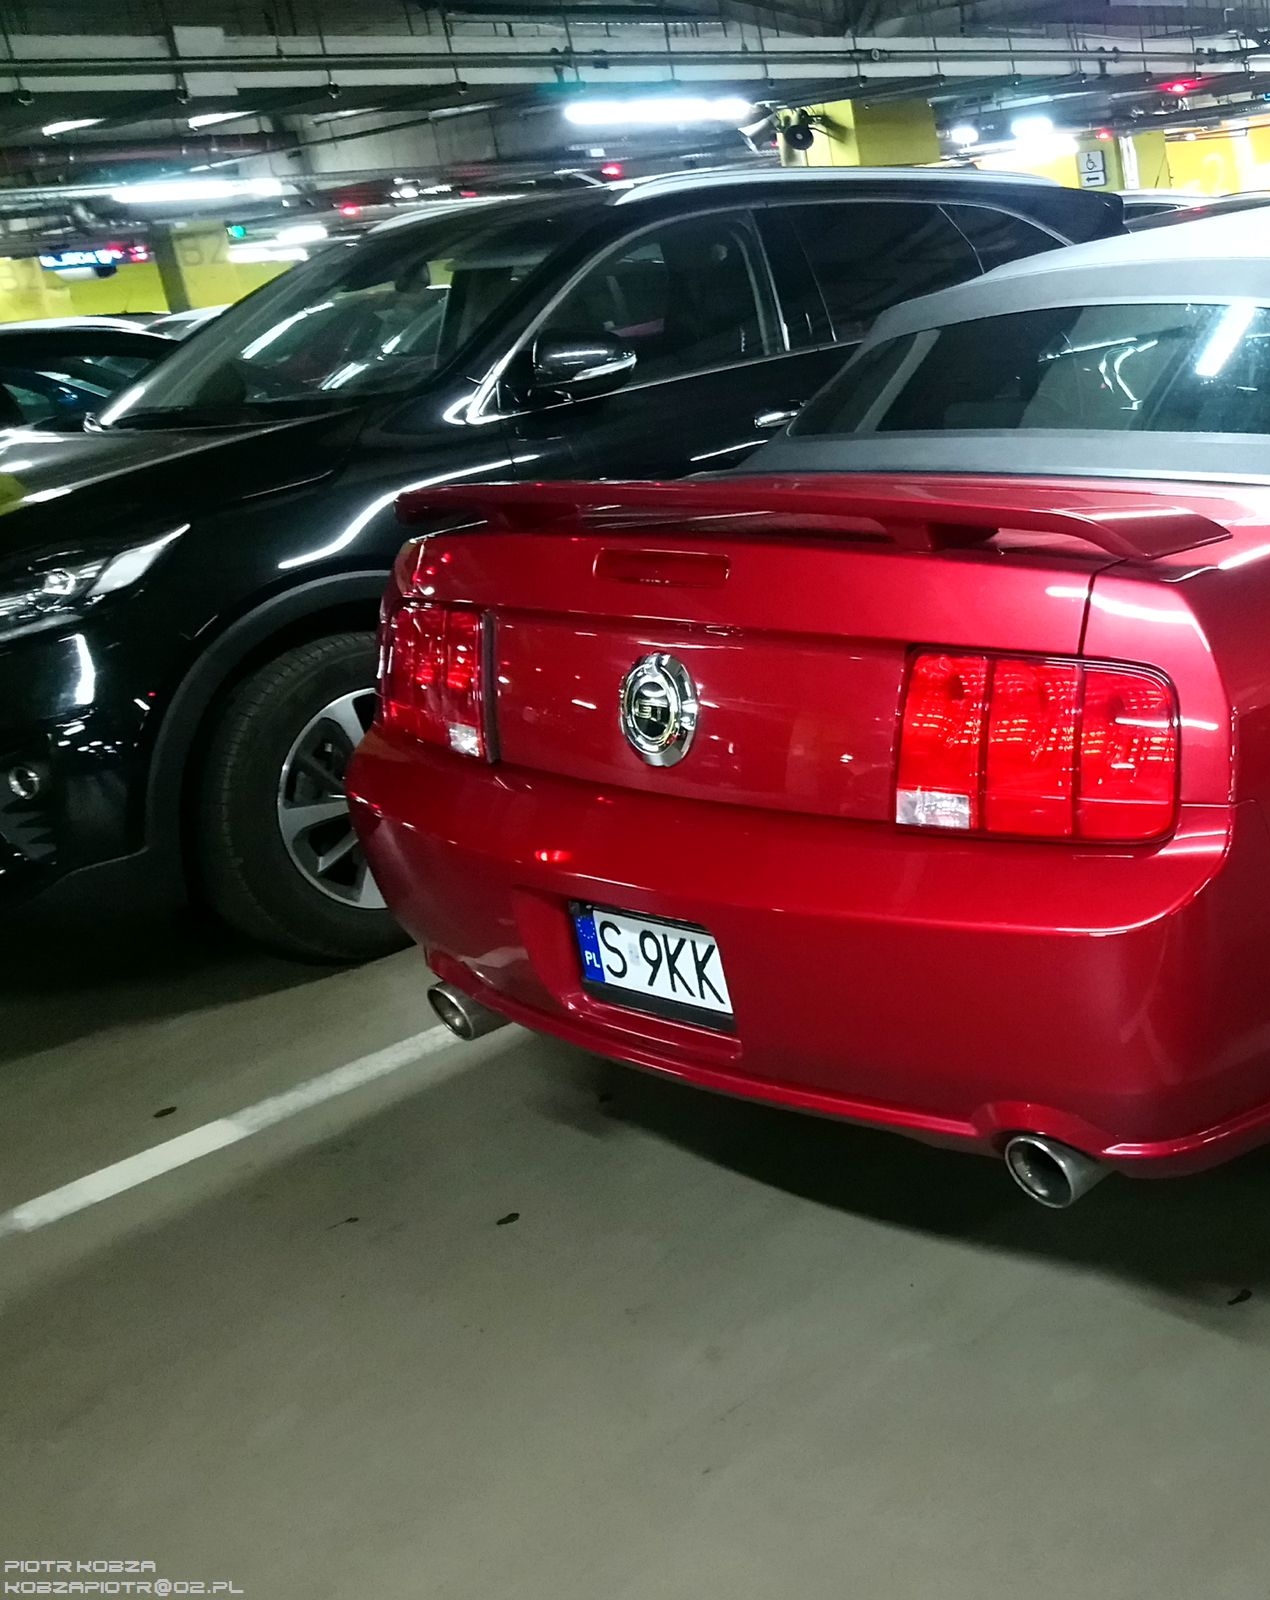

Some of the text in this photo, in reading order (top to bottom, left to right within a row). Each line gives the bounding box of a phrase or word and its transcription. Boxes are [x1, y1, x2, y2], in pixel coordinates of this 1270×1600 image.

[584, 950, 601, 969] PL
[599, 920, 726, 1005] S 9KK
